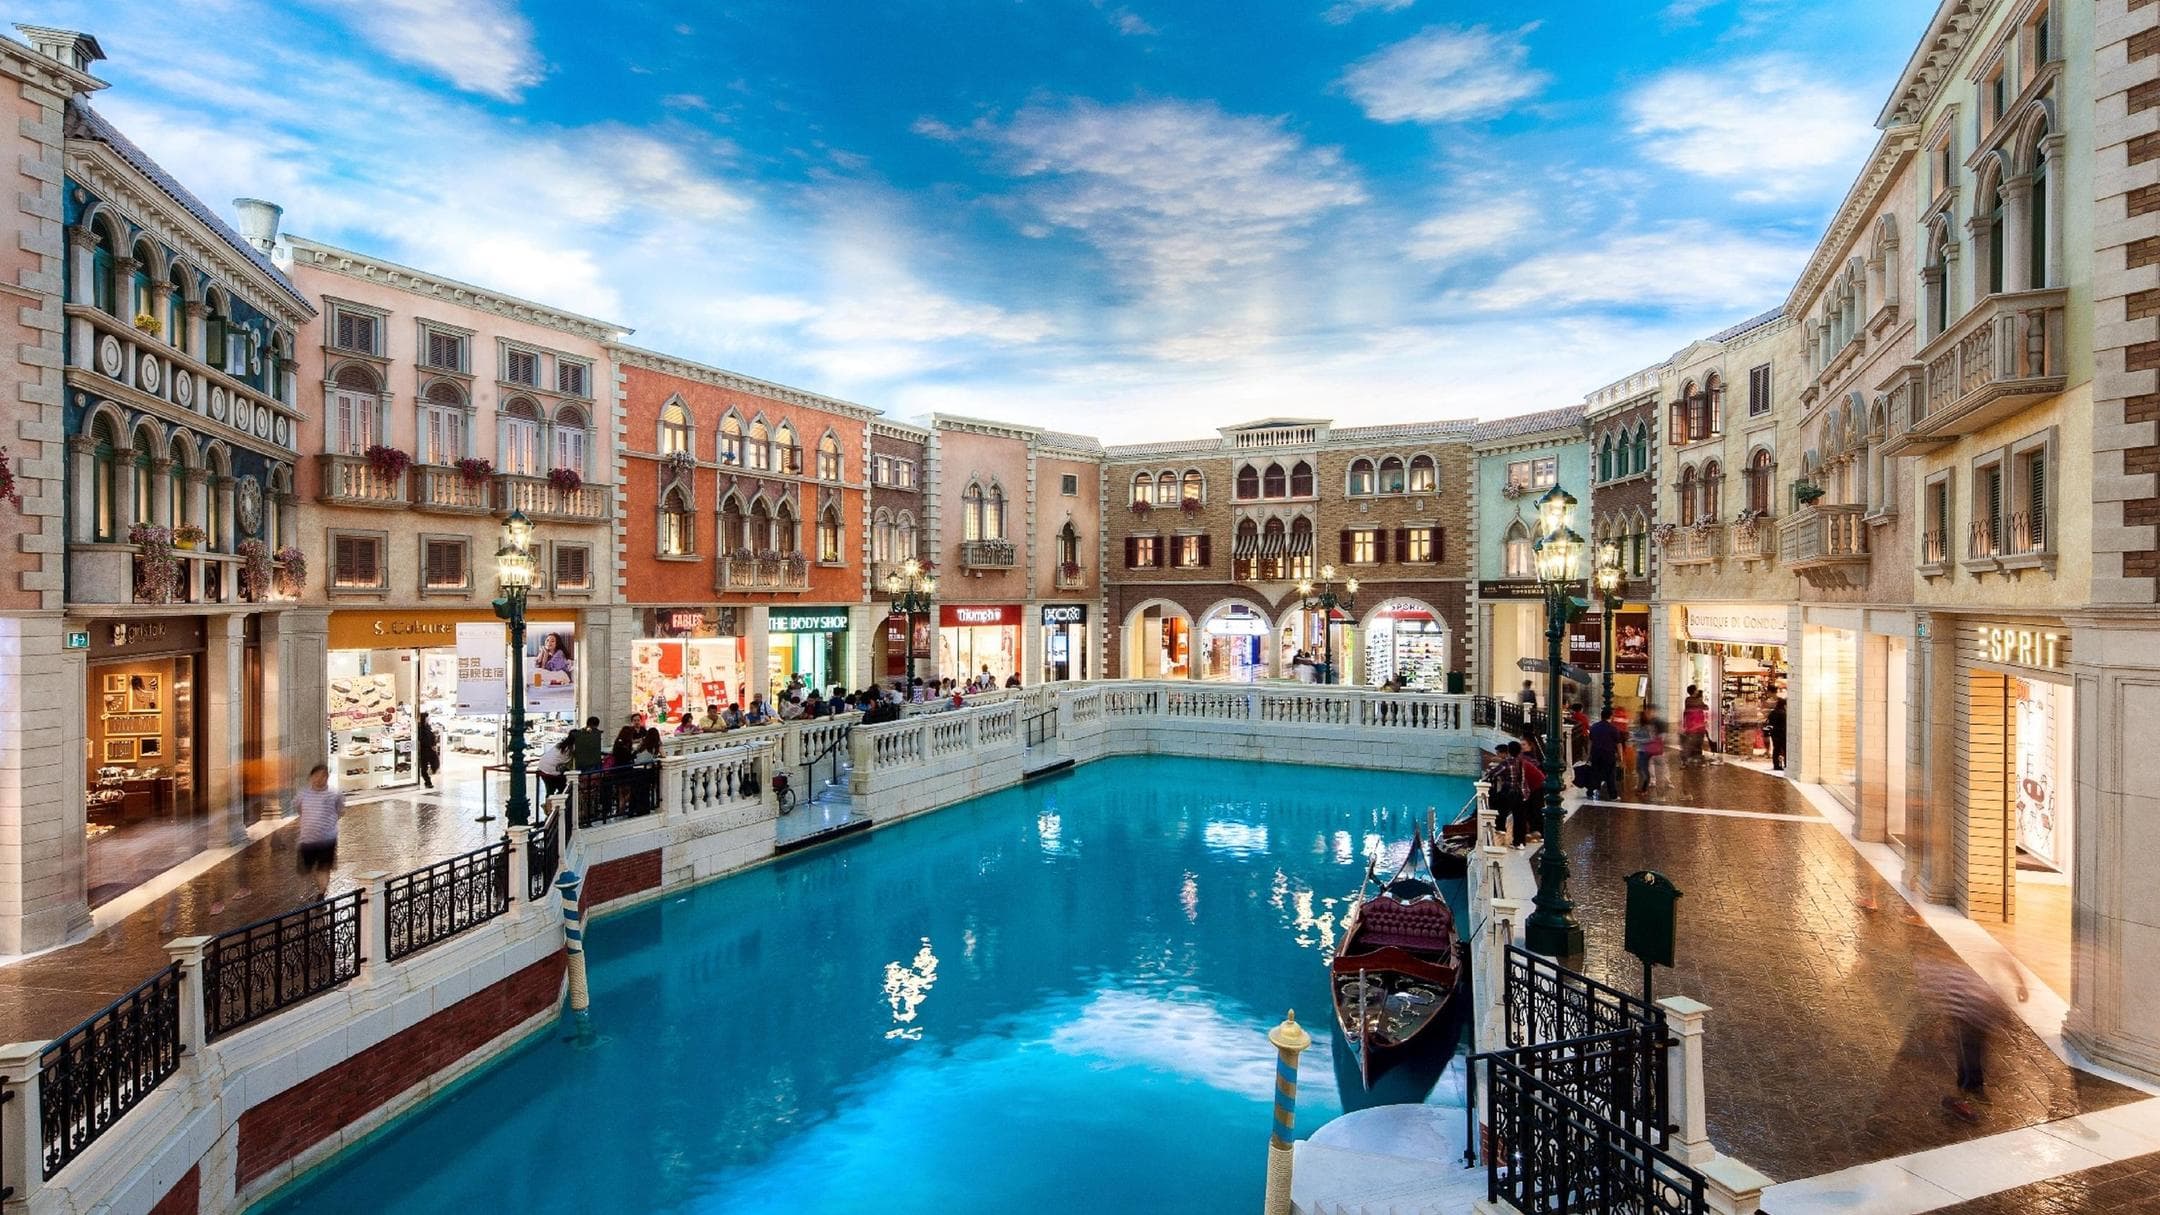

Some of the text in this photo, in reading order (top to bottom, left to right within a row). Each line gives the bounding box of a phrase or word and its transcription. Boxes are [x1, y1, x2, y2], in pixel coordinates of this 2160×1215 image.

[957, 608, 994, 622] Triumph
[1045, 606, 1079, 620] HOM
[672, 614, 702, 628] FABLES
[769, 616, 788, 630] THE
[790, 616, 819, 630] BODY
[1690, 614, 1728, 629] BOUTIQUE
[1978, 626, 2057, 669] ESPRIT
